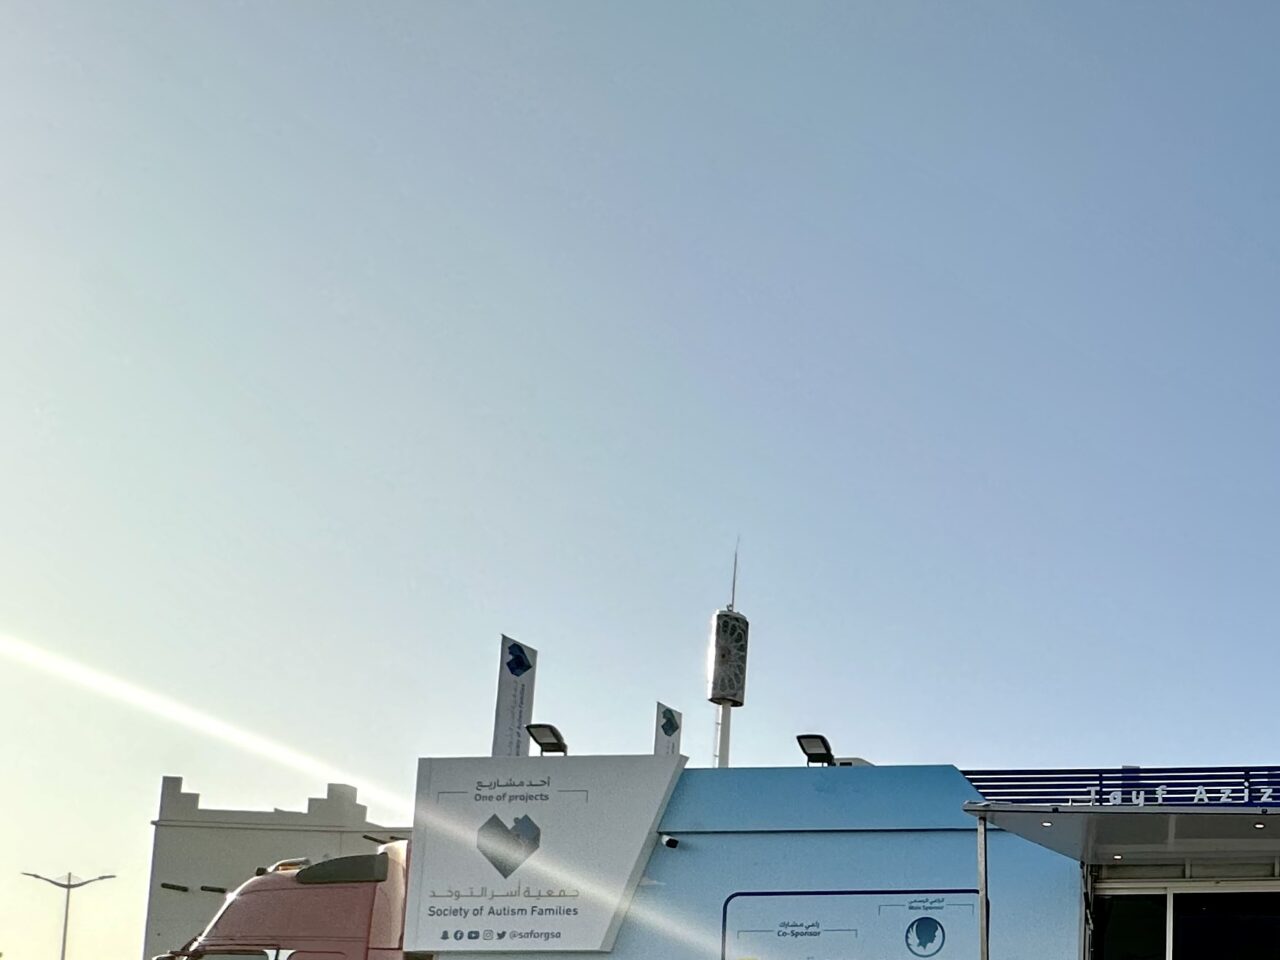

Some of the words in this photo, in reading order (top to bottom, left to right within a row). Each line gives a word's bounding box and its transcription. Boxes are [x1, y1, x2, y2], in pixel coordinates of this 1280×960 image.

[476, 778, 524, 791] مشاريع
[526, 776, 551, 787] أحد
[475, 793, 494, 802] One
[496, 792, 507, 801] of
[508, 792, 550, 803] projects
[1087, 785, 1167, 806] Tayf
[1194, 781, 1274, 803] Aziz
[429, 886, 487, 900] التوحد
[428, 906, 470, 919] Society
[472, 906, 484, 917] of
[488, 906, 527, 917] Autism
[531, 905, 579, 916] Families
[509, 930, 562, 941] @saforgsa
[777, 930, 821, 938] Co-Sponsor
